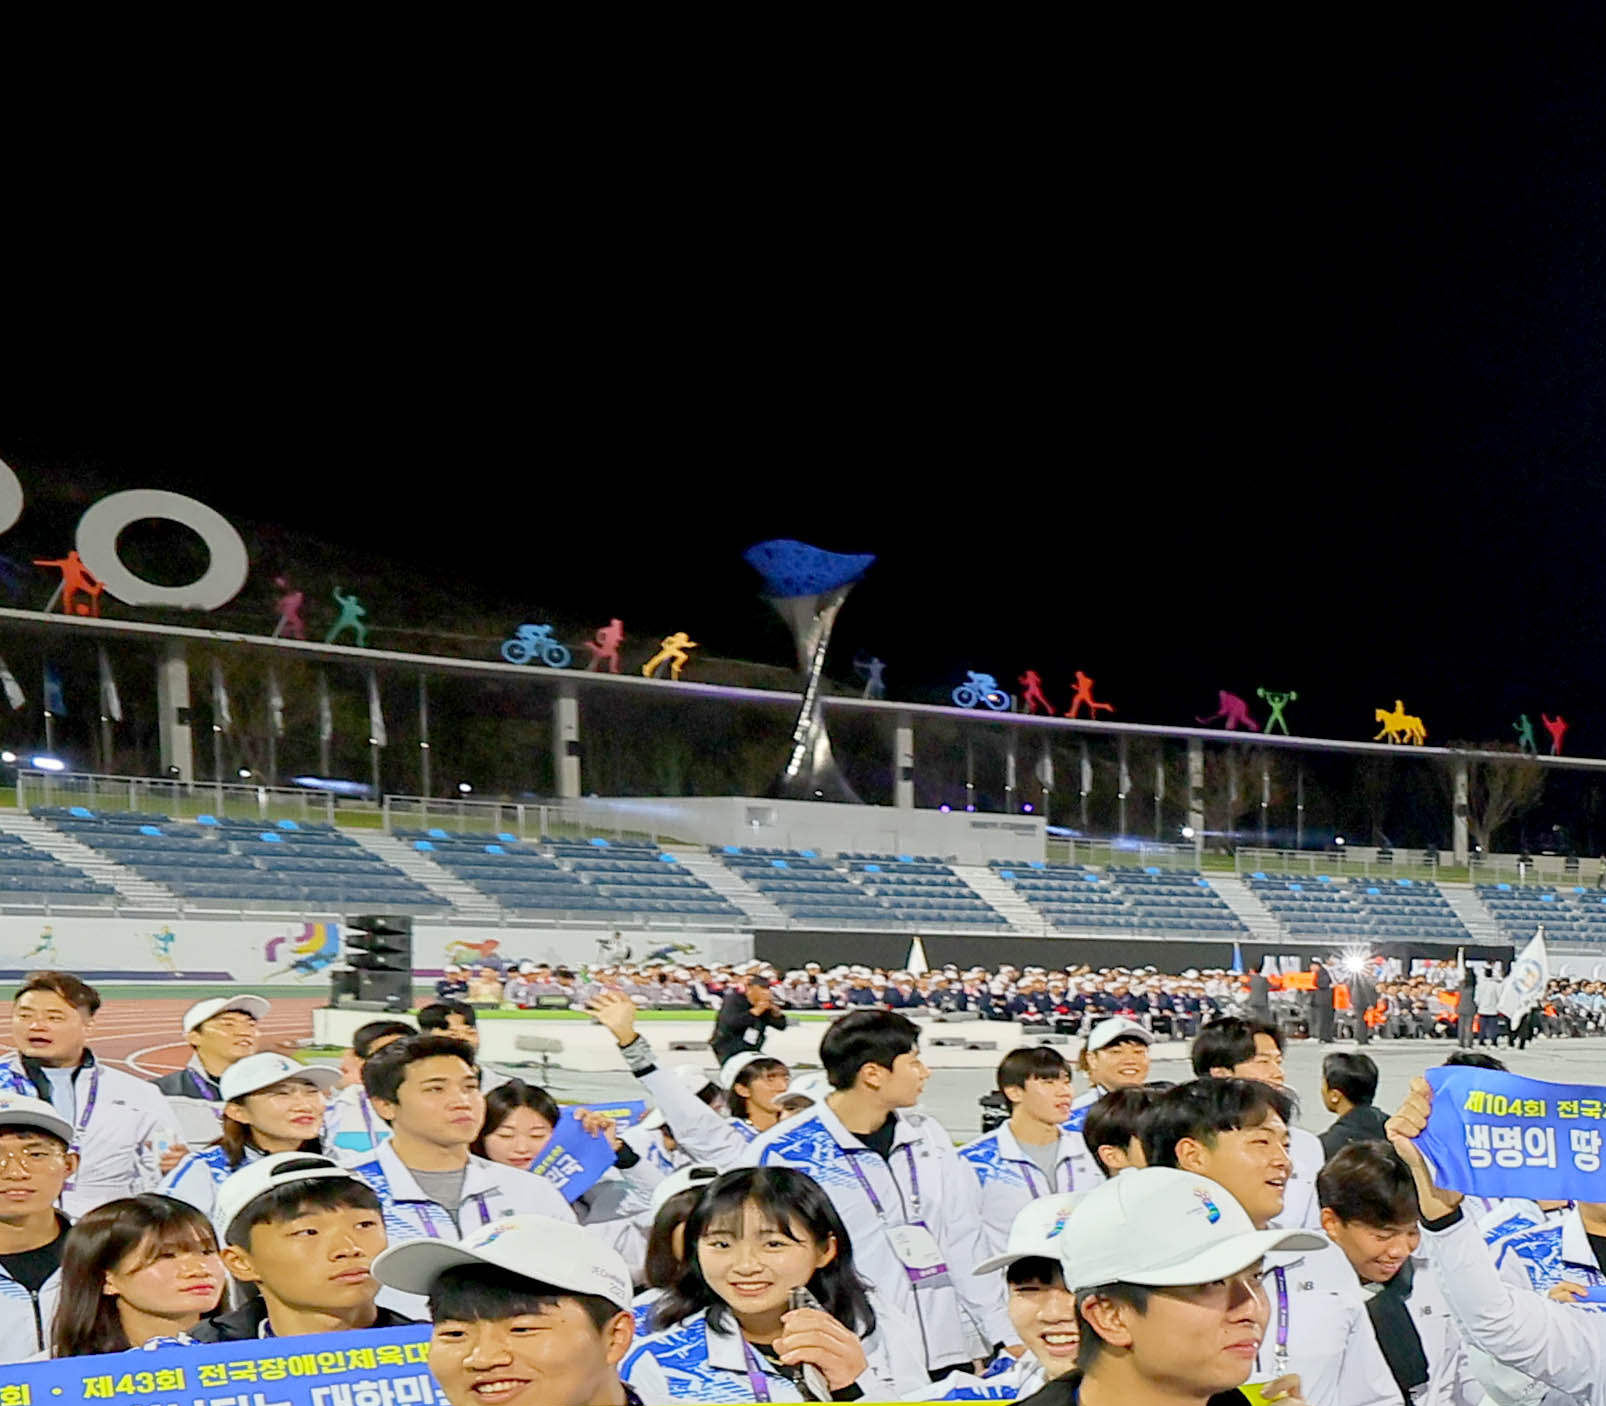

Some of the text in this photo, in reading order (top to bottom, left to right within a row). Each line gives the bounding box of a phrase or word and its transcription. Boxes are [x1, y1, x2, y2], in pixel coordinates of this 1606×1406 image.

[1464, 1090, 1546, 1117] 제104회
[1464, 1123, 1557, 1169] 생명의
[1570, 1129, 1602, 1172] 땅
[82, 1341, 431, 1399] 제43회 전국장애인체육대
